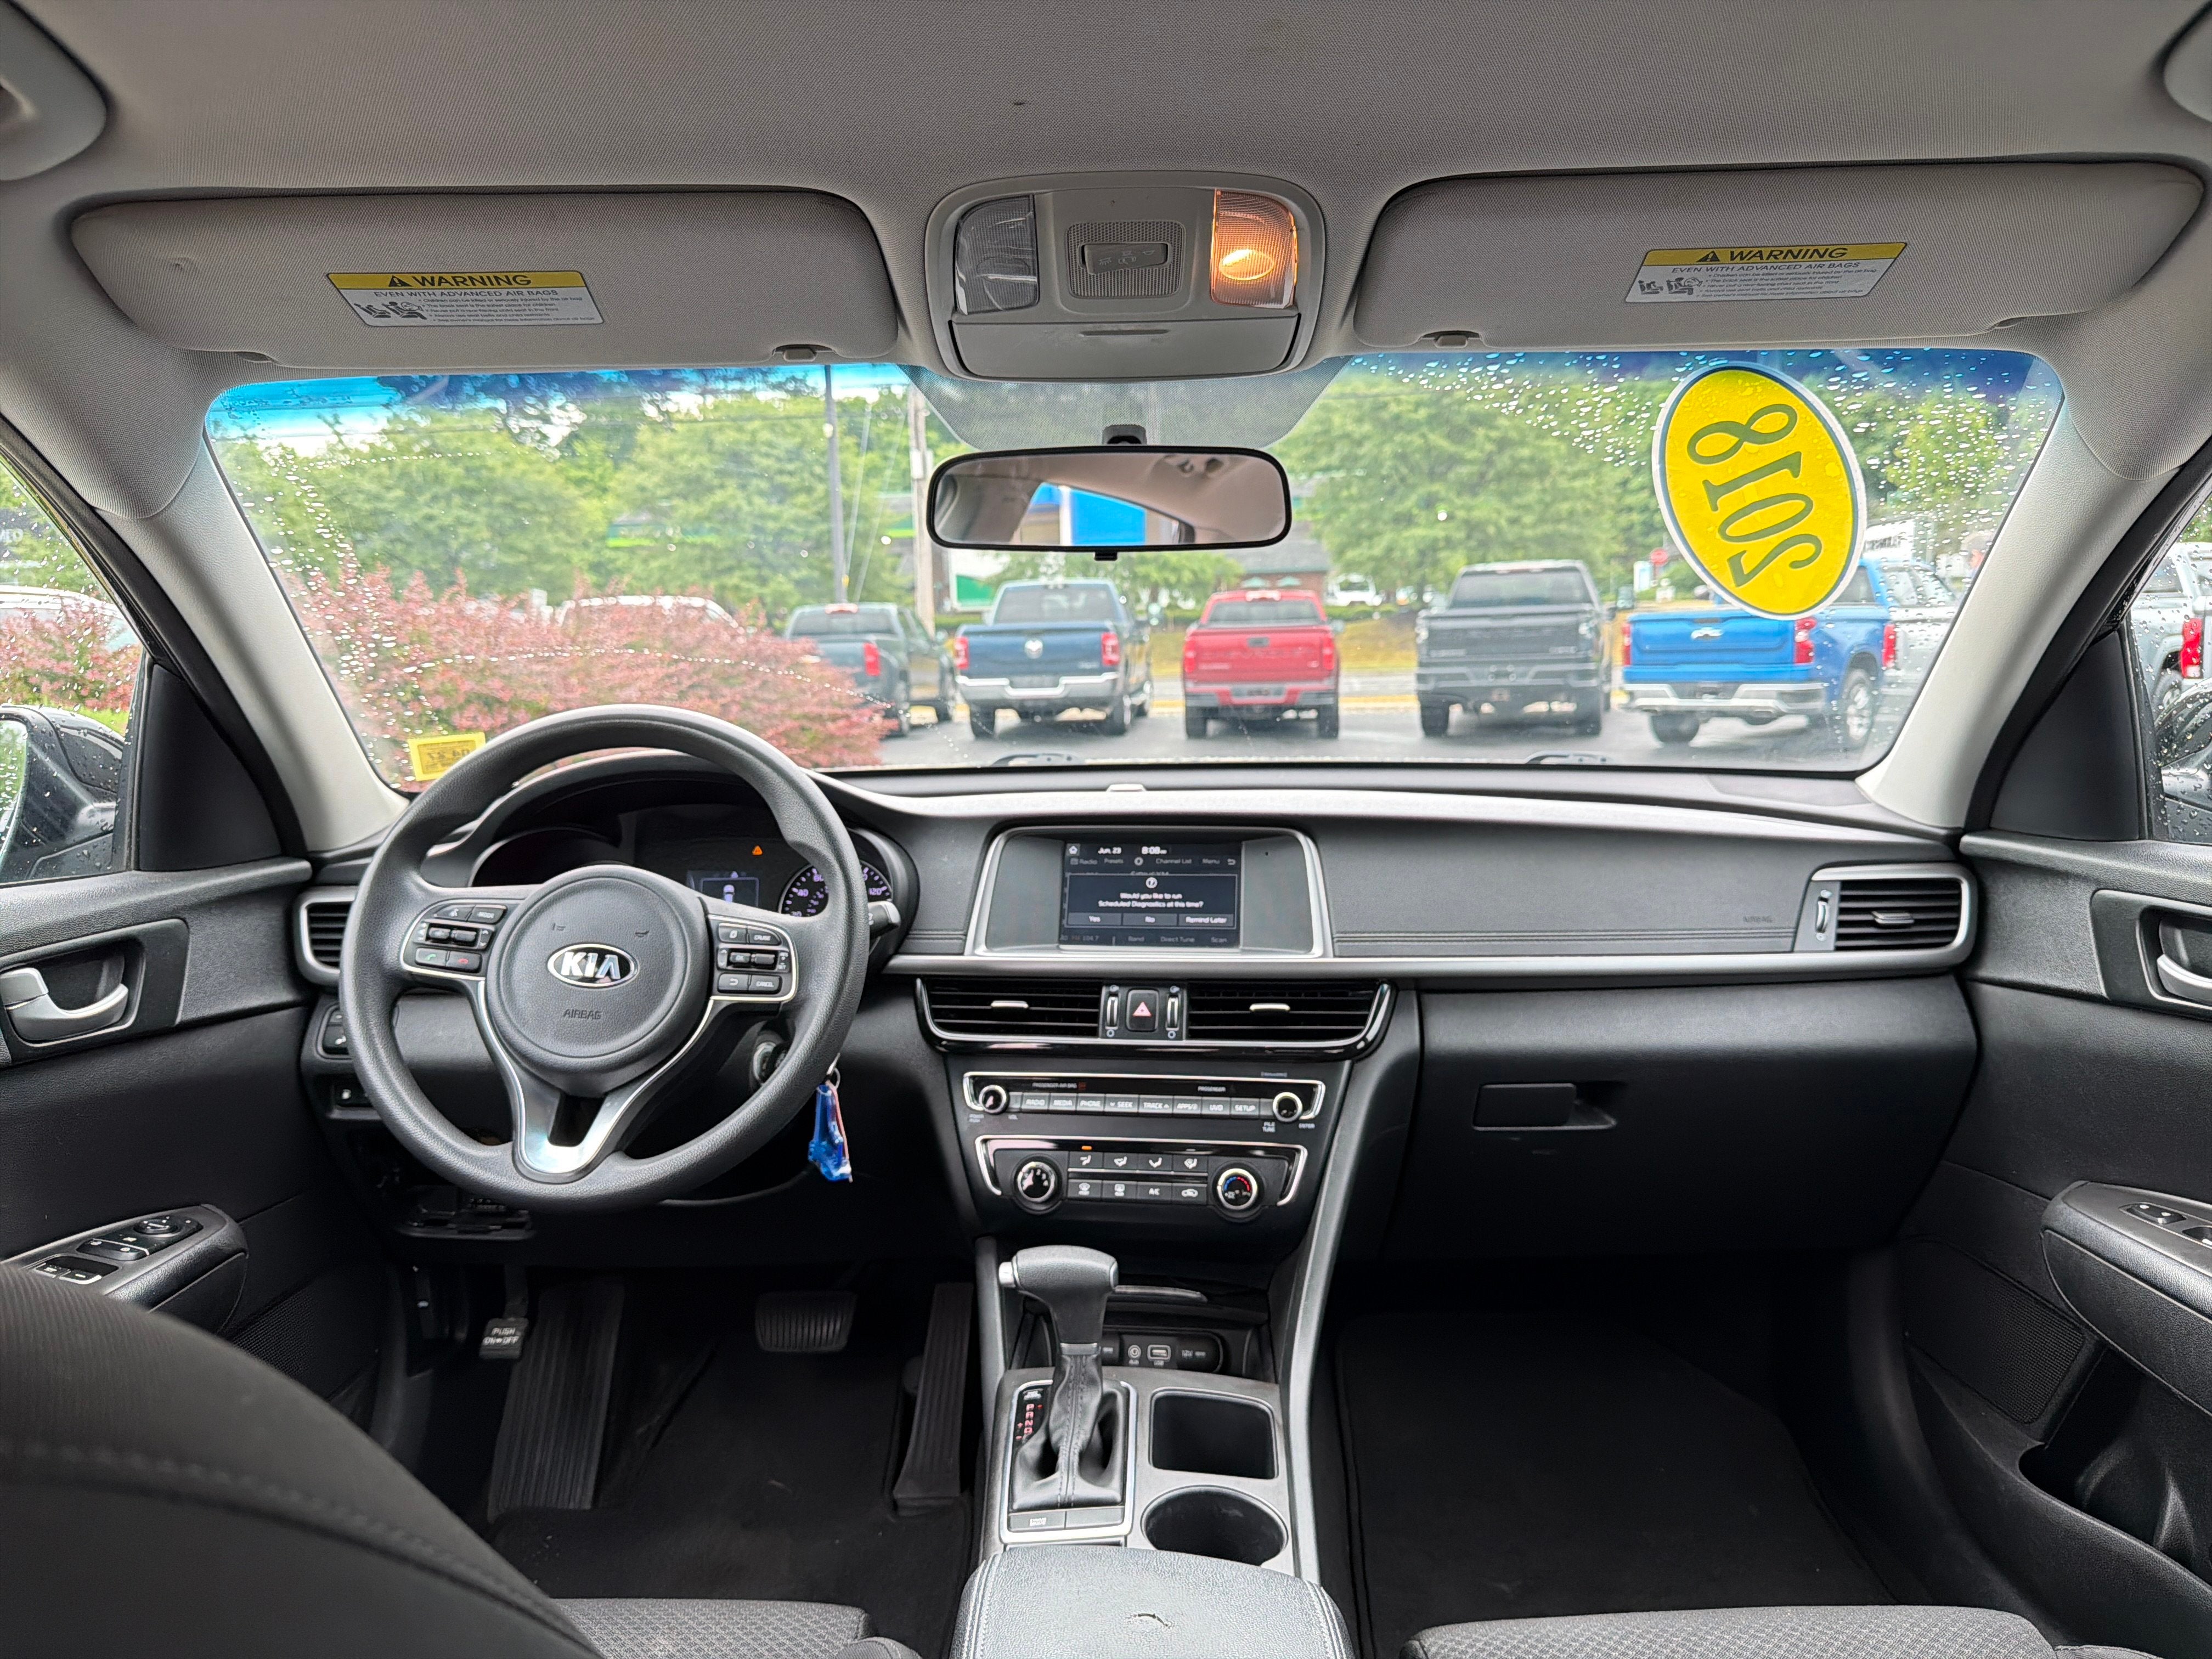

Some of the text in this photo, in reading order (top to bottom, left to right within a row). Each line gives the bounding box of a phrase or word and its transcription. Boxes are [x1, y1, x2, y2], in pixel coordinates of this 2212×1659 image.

[1730, 247, 1848, 261] WARNING
[412, 275, 531, 287] WARNING
[561, 952, 621, 980] KIA
[562, 1009, 603, 1020] AIRBAG
